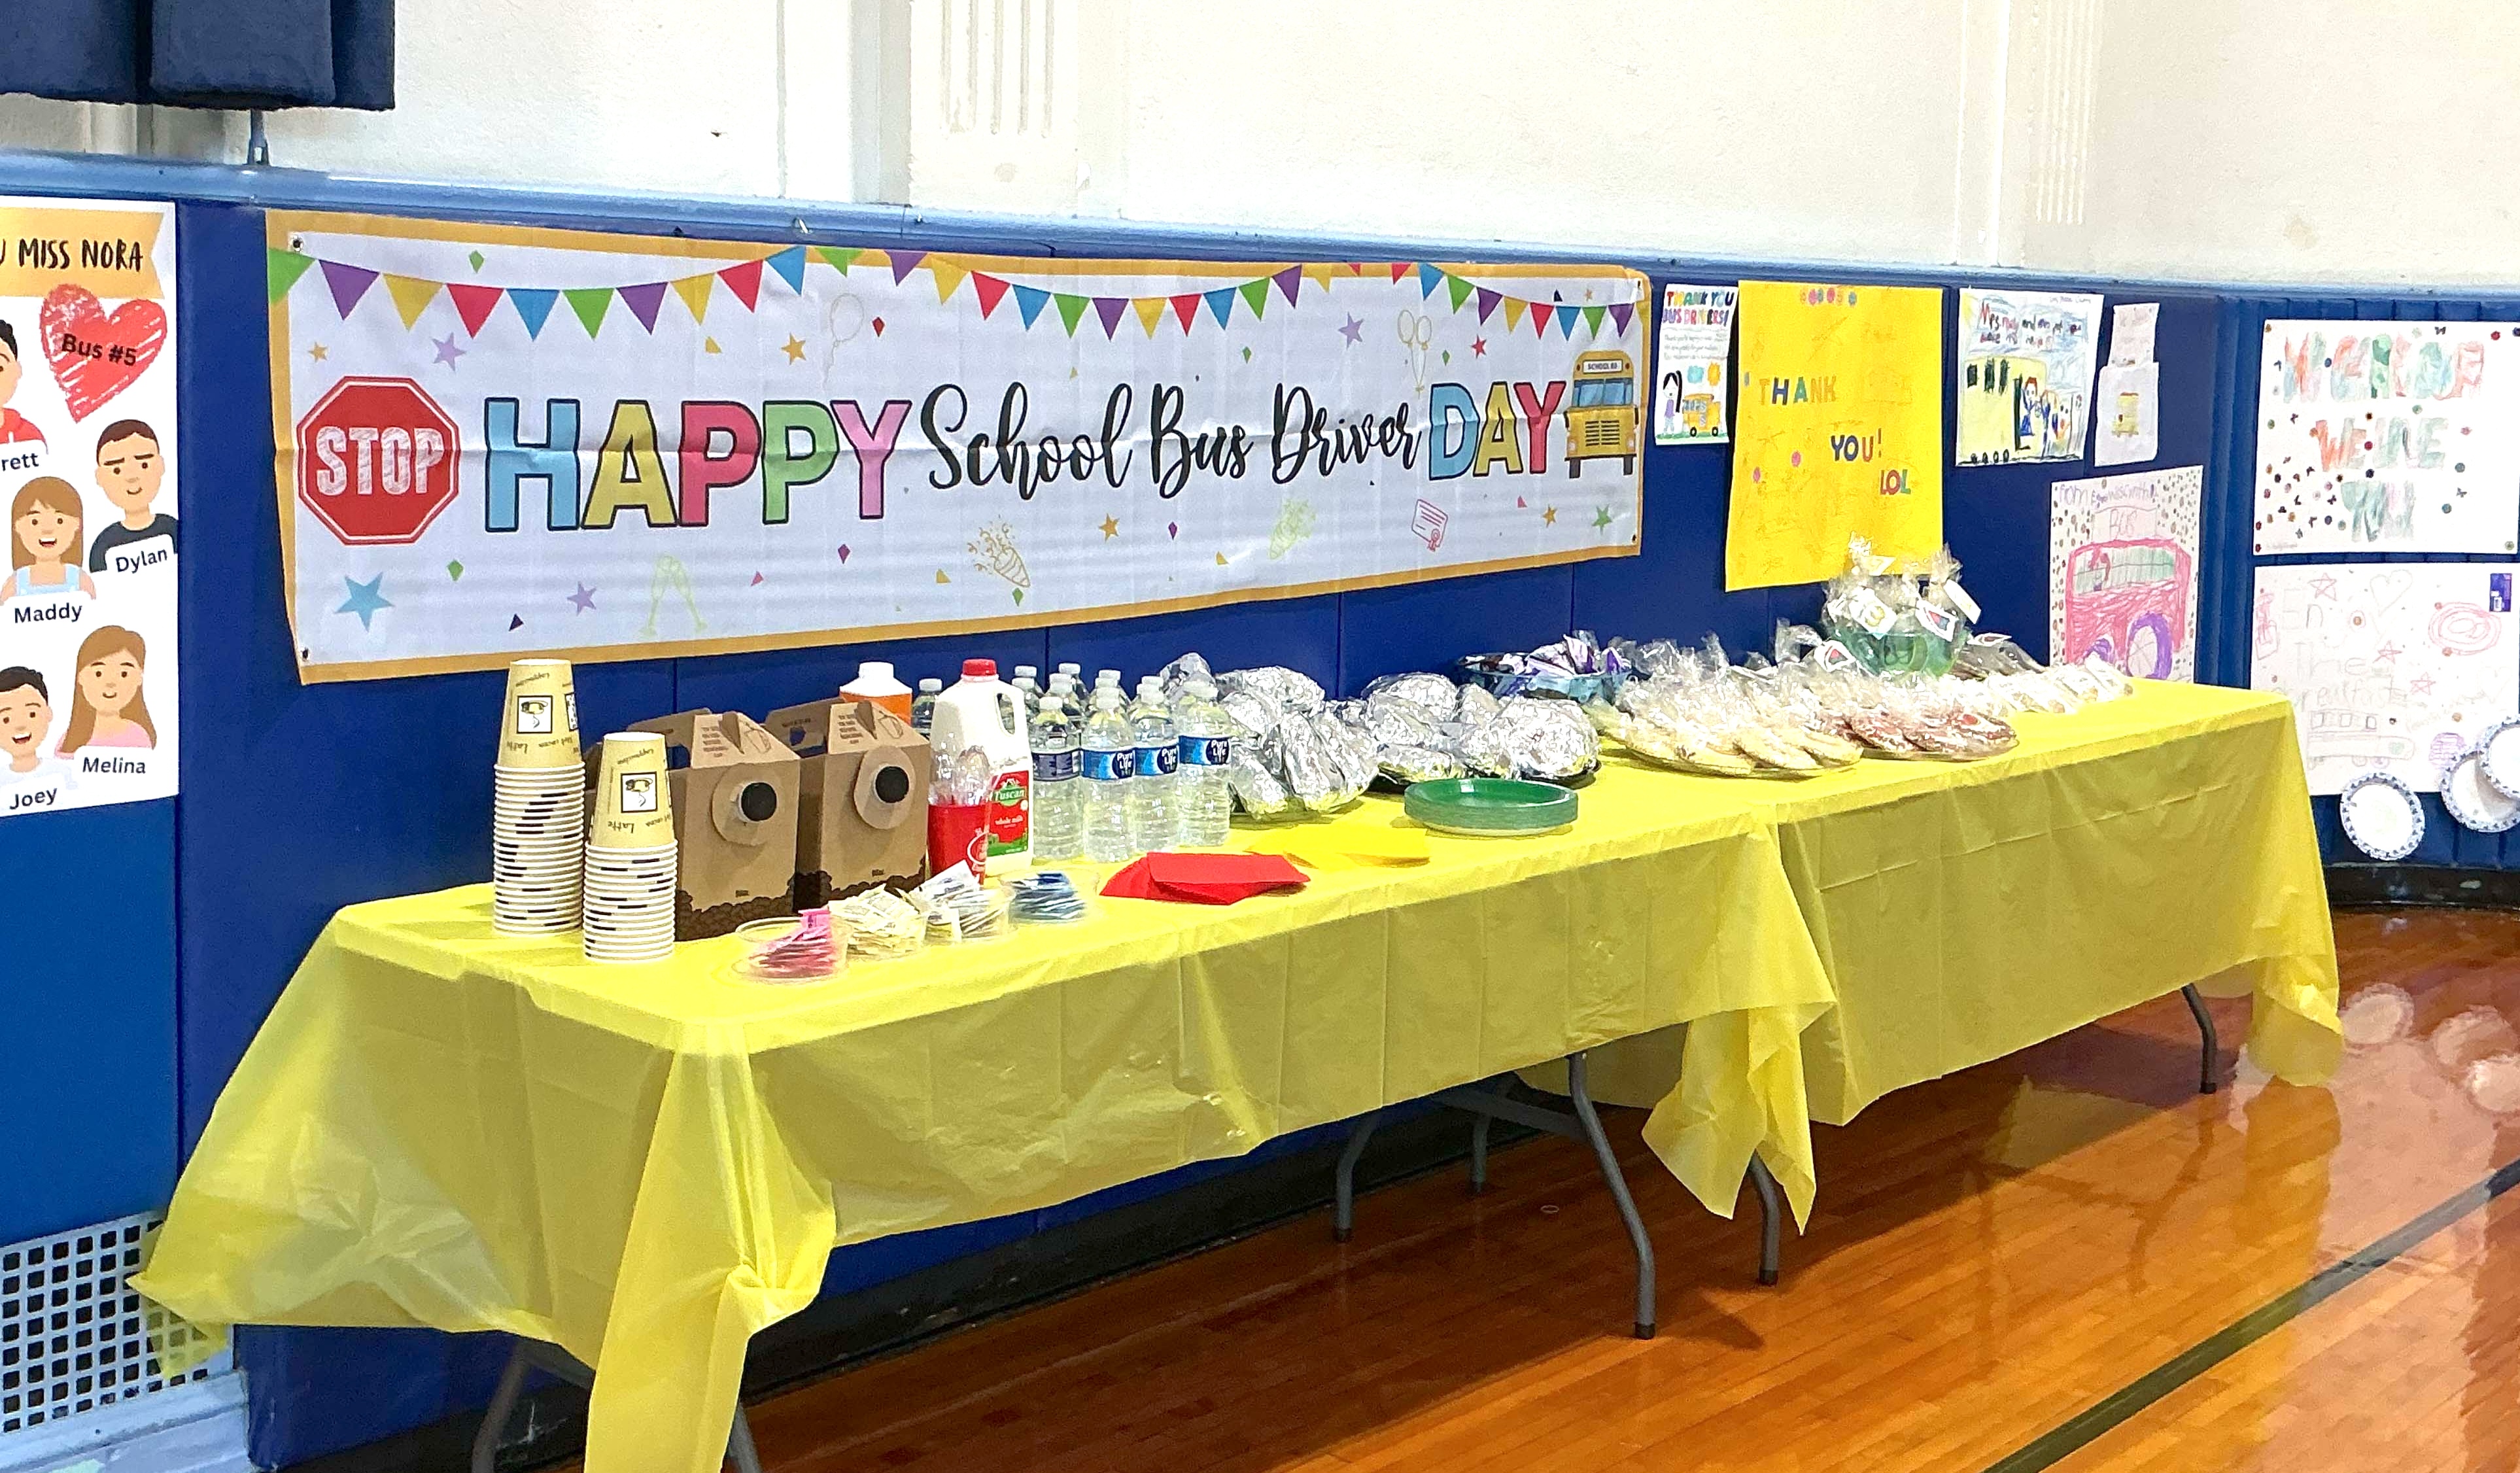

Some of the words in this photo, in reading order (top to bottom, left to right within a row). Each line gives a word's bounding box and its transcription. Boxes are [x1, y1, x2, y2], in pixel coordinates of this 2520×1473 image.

[19, 238, 70, 269] MISS
[82, 239, 143, 272] NORA
[1666, 291, 1708, 307] THANK
[1711, 291, 1735, 307] YOU
[61, 333, 103, 359] Bus
[109, 345, 137, 366] #5
[1759, 376, 1837, 406] THANK
[484, 398, 912, 532] HAPPY
[920, 381, 1133, 500] School
[1150, 383, 1254, 499] Bus
[1271, 383, 1422, 484] Driver
[1429, 380, 1567, 481] DAY
[1831, 428, 1882, 462] YOU!
[316, 426, 443, 495] STOP
[1879, 469, 1911, 495] LOL
[116, 549, 167, 573] Dylan
[14, 602, 82, 623] Maddy
[82, 757, 146, 774] Melina
[9, 788, 58, 810] Joey
[995, 789, 1026, 802] Tuscan
[608, 820, 634, 833] Latte
